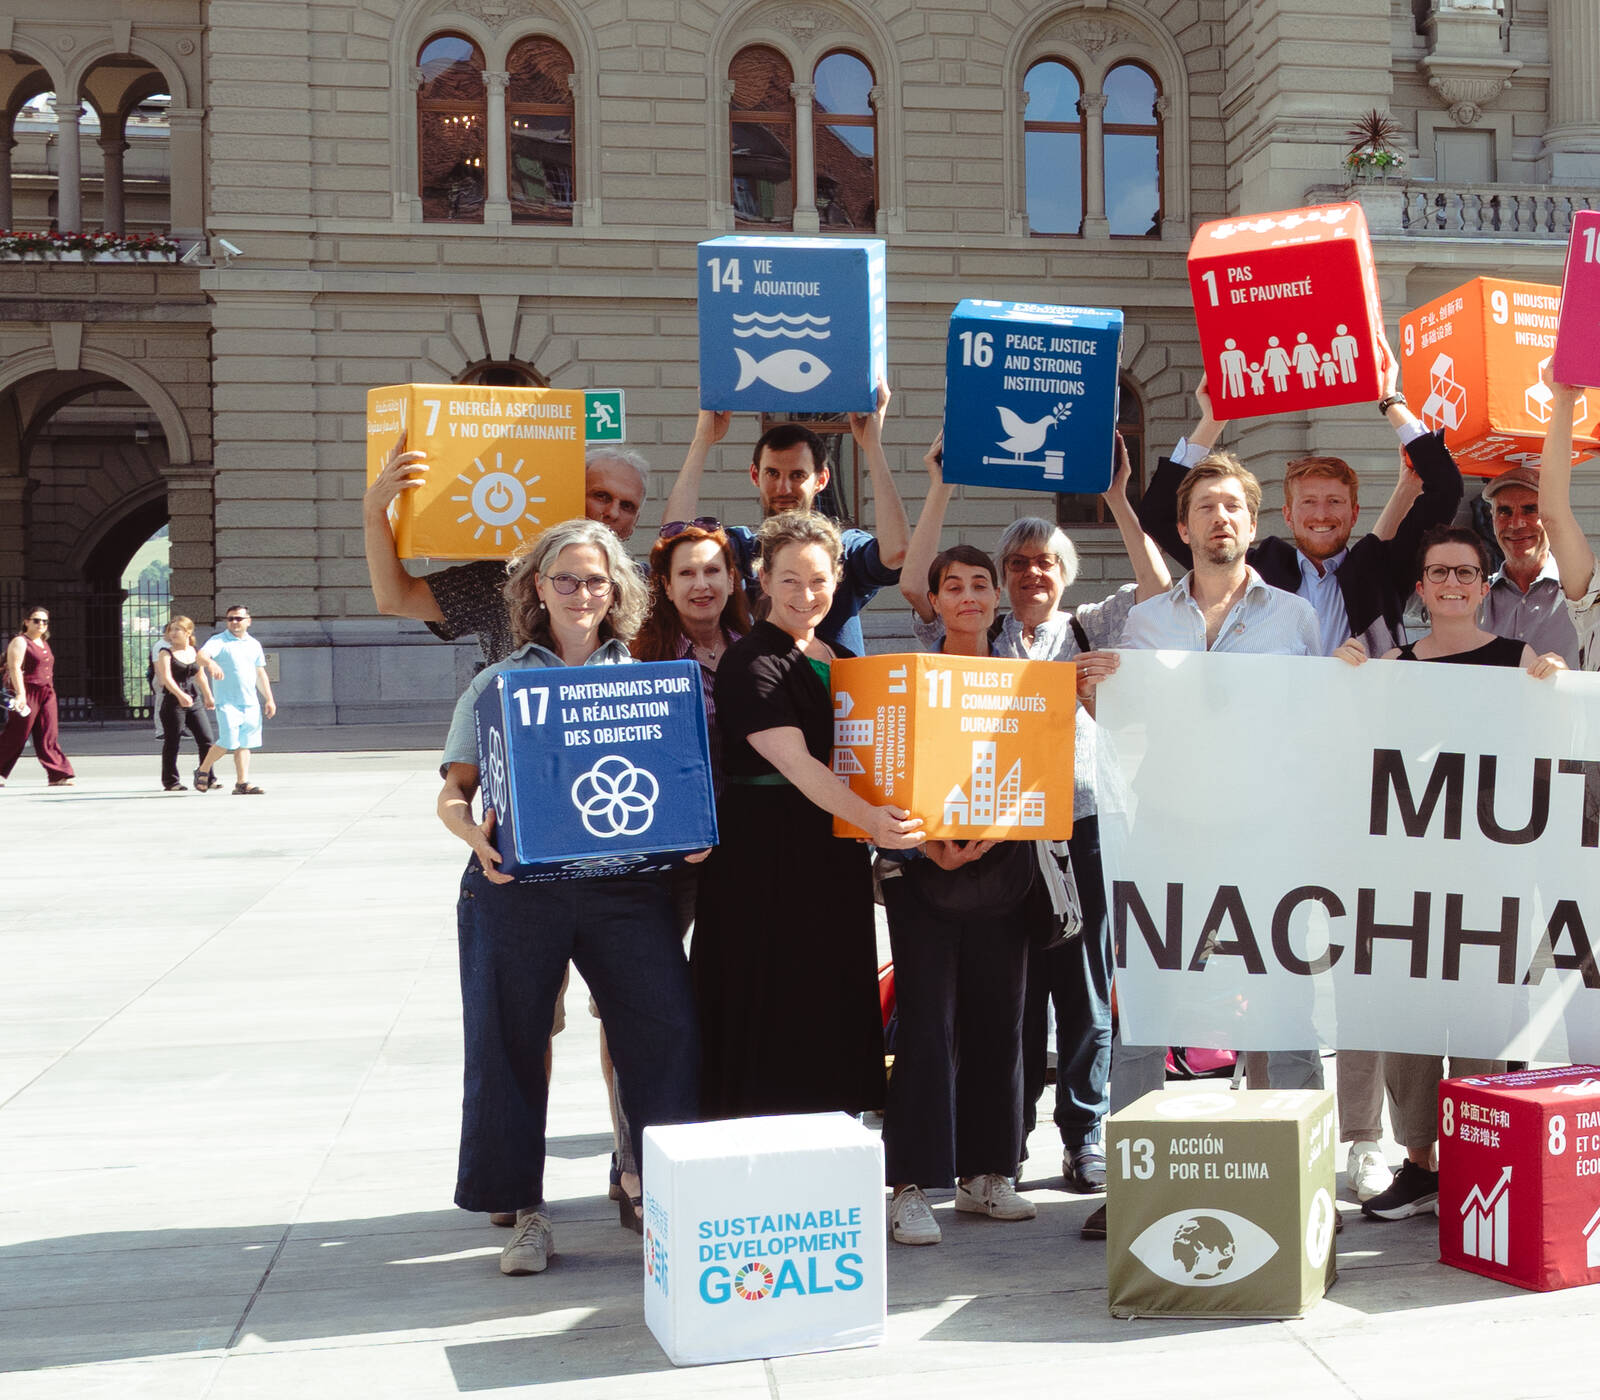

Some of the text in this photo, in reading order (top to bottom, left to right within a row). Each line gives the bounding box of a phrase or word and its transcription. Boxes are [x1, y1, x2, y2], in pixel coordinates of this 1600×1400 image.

[707, 258, 743, 293] 14
[753, 260, 772, 274] VIE
[1227, 266, 1253, 283] PAS
[753, 281, 820, 297] AQUATIQUE
[1201, 270, 1220, 307] 1
[1230, 276, 1313, 304] DE PAUVRETÉ
[1491, 290, 1508, 324] 9
[959, 331, 994, 368] 16
[1005, 334, 1098, 356] PEACE, JUSTICE
[1404, 324, 1415, 357] 9
[1004, 355, 1082, 375] AND STRONG
[1003, 375, 1085, 396] INSTITUTIONS
[423, 400, 441, 436] 7
[449, 398, 573, 419] ENERGÍA ASEQUIBLE
[449, 423, 577, 441] Y NO CONTAMINANTE
[560, 677, 690, 700] PARTENARIATS POUR
[889, 664, 907, 694] 11
[924, 670, 952, 708] 11
[963, 672, 1014, 688] VILLES ET
[513, 687, 549, 726] 17
[562, 701, 669, 723] LA RÉALISATION
[961, 693, 1047, 712] COMMUNAUTÉS
[564, 724, 662, 746] DES OBJECTIFS
[960, 717, 1019, 733] DURABLES
[874, 706, 885, 787] SOSTENIBLES
[885, 705, 896, 798] COMUNIDADES
[896, 705, 906, 780] CIUDADES Y
[1442, 1097, 1455, 1137] 8
[1459, 1101, 1510, 1129] 体面工作和
[1169, 1133, 1224, 1155] ACCIÓN
[1459, 1124, 1501, 1149] 经济增长
[1548, 1114, 1567, 1156] 8
[1576, 1137, 1588, 1153] ET
[1116, 1138, 1155, 1180] 13
[1169, 1163, 1270, 1180] POR EL CLIMA
[698, 1207, 861, 1240] SUSTAINABLE
[699, 1230, 862, 1262] DEVELOPMENT
[699, 1253, 864, 1305] GOALS
